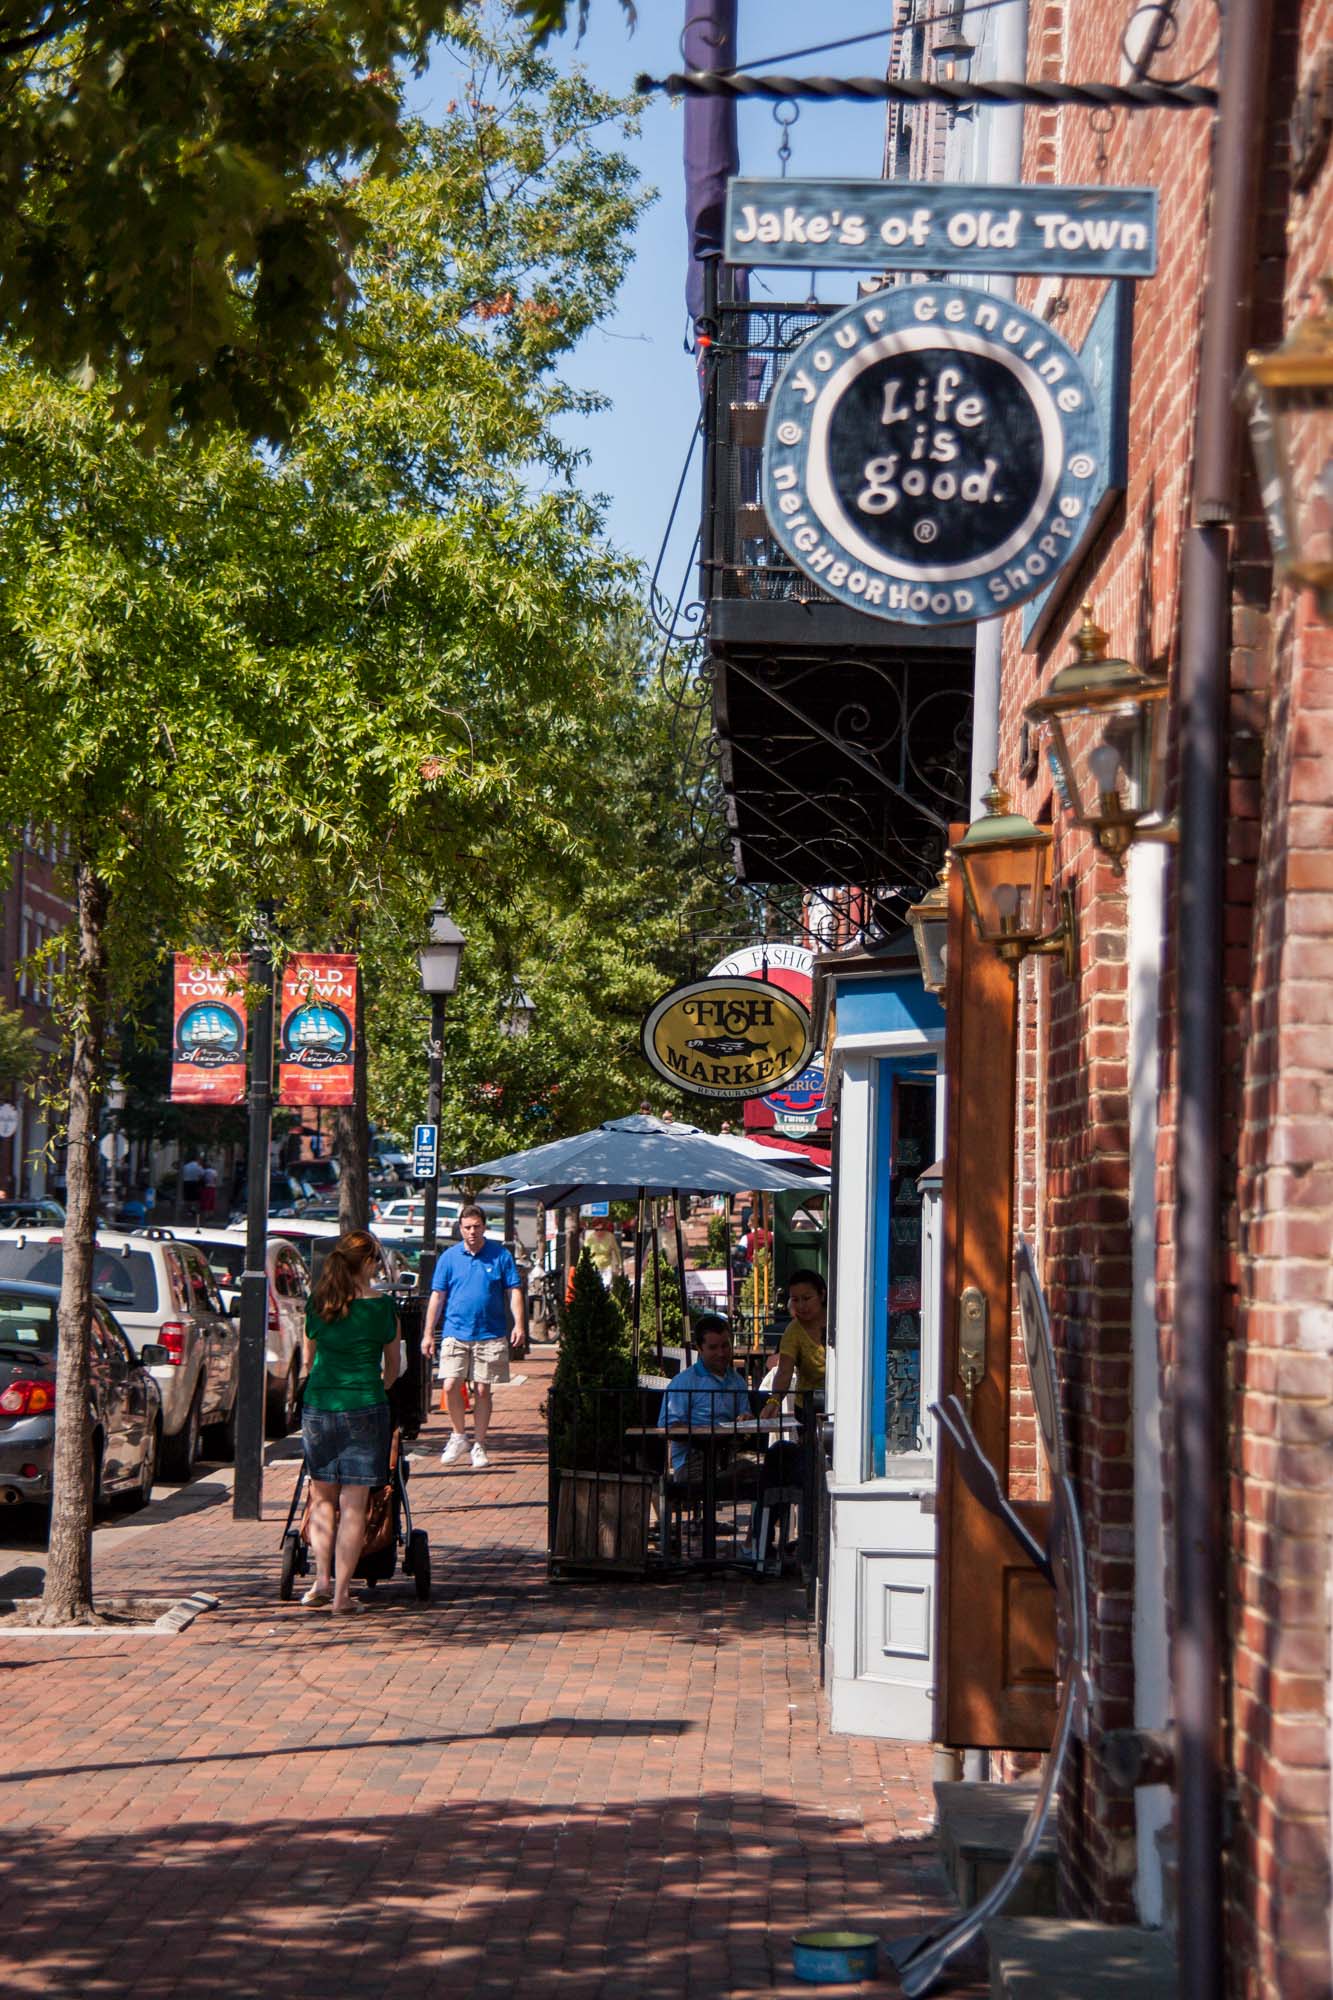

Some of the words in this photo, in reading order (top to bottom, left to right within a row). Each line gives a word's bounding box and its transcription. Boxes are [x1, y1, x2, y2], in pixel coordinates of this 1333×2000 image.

[735, 206, 866, 245] Jake's
[880, 210, 930, 246] of
[947, 210, 1021, 249] Old
[1034, 214, 1148, 251] Town
[881, 368, 985, 428] Life
[911, 425, 960, 463] is
[857, 454, 1003, 516] good.
[188, 968, 235, 981] OLD
[286, 983, 353, 997] TOWN
[298, 969, 343, 983] OLD
[682, 1000, 775, 1035] FISH
[666, 1045, 793, 1085] MARKET
